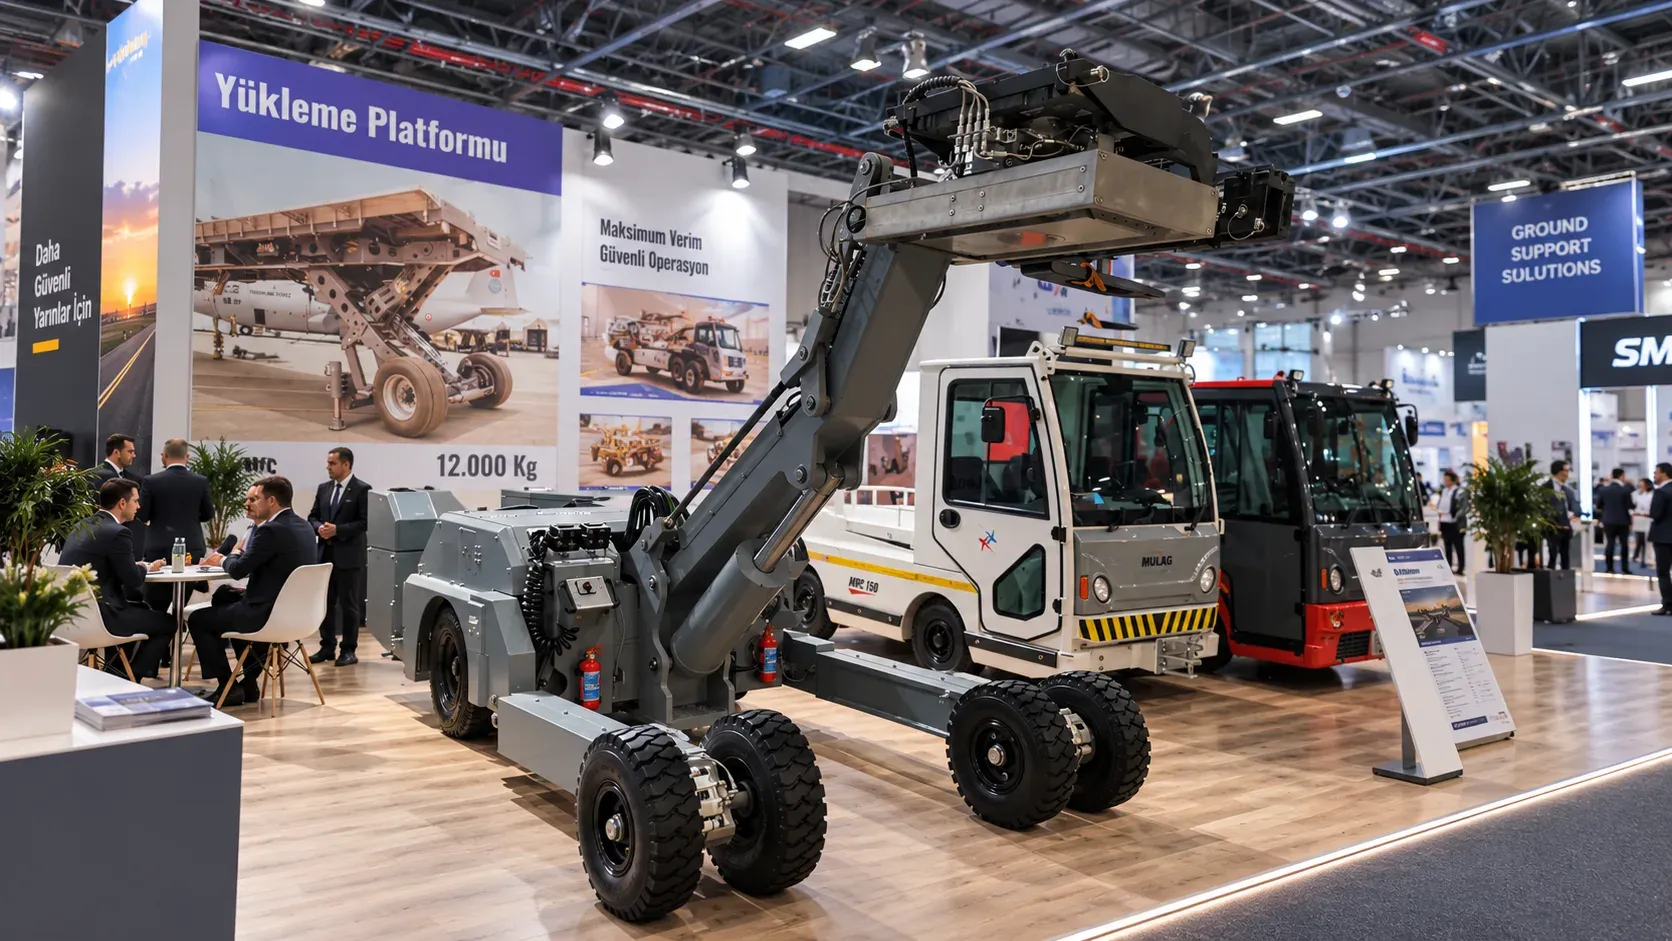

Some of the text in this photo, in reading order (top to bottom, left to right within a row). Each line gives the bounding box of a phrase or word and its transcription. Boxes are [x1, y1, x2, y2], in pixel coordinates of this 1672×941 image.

[215, 71, 508, 164] Yükleme Platformu
[600, 218, 702, 250] Maksimum Verim
[1512, 216, 1588, 240] GROUND
[35, 239, 60, 266] Daha
[600, 244, 709, 276] Güvenli Operasyon
[1511, 238, 1592, 262] SUPPORT
[35, 266, 71, 297] Güvenli
[1501, 259, 1601, 284] SOLUTIONS
[33, 292, 92, 330] Yarınlar İçin
[437, 453, 538, 481] 12.000 Kg
[1141, 555, 1173, 567] MULAG
[866, 580, 879, 593] 150
